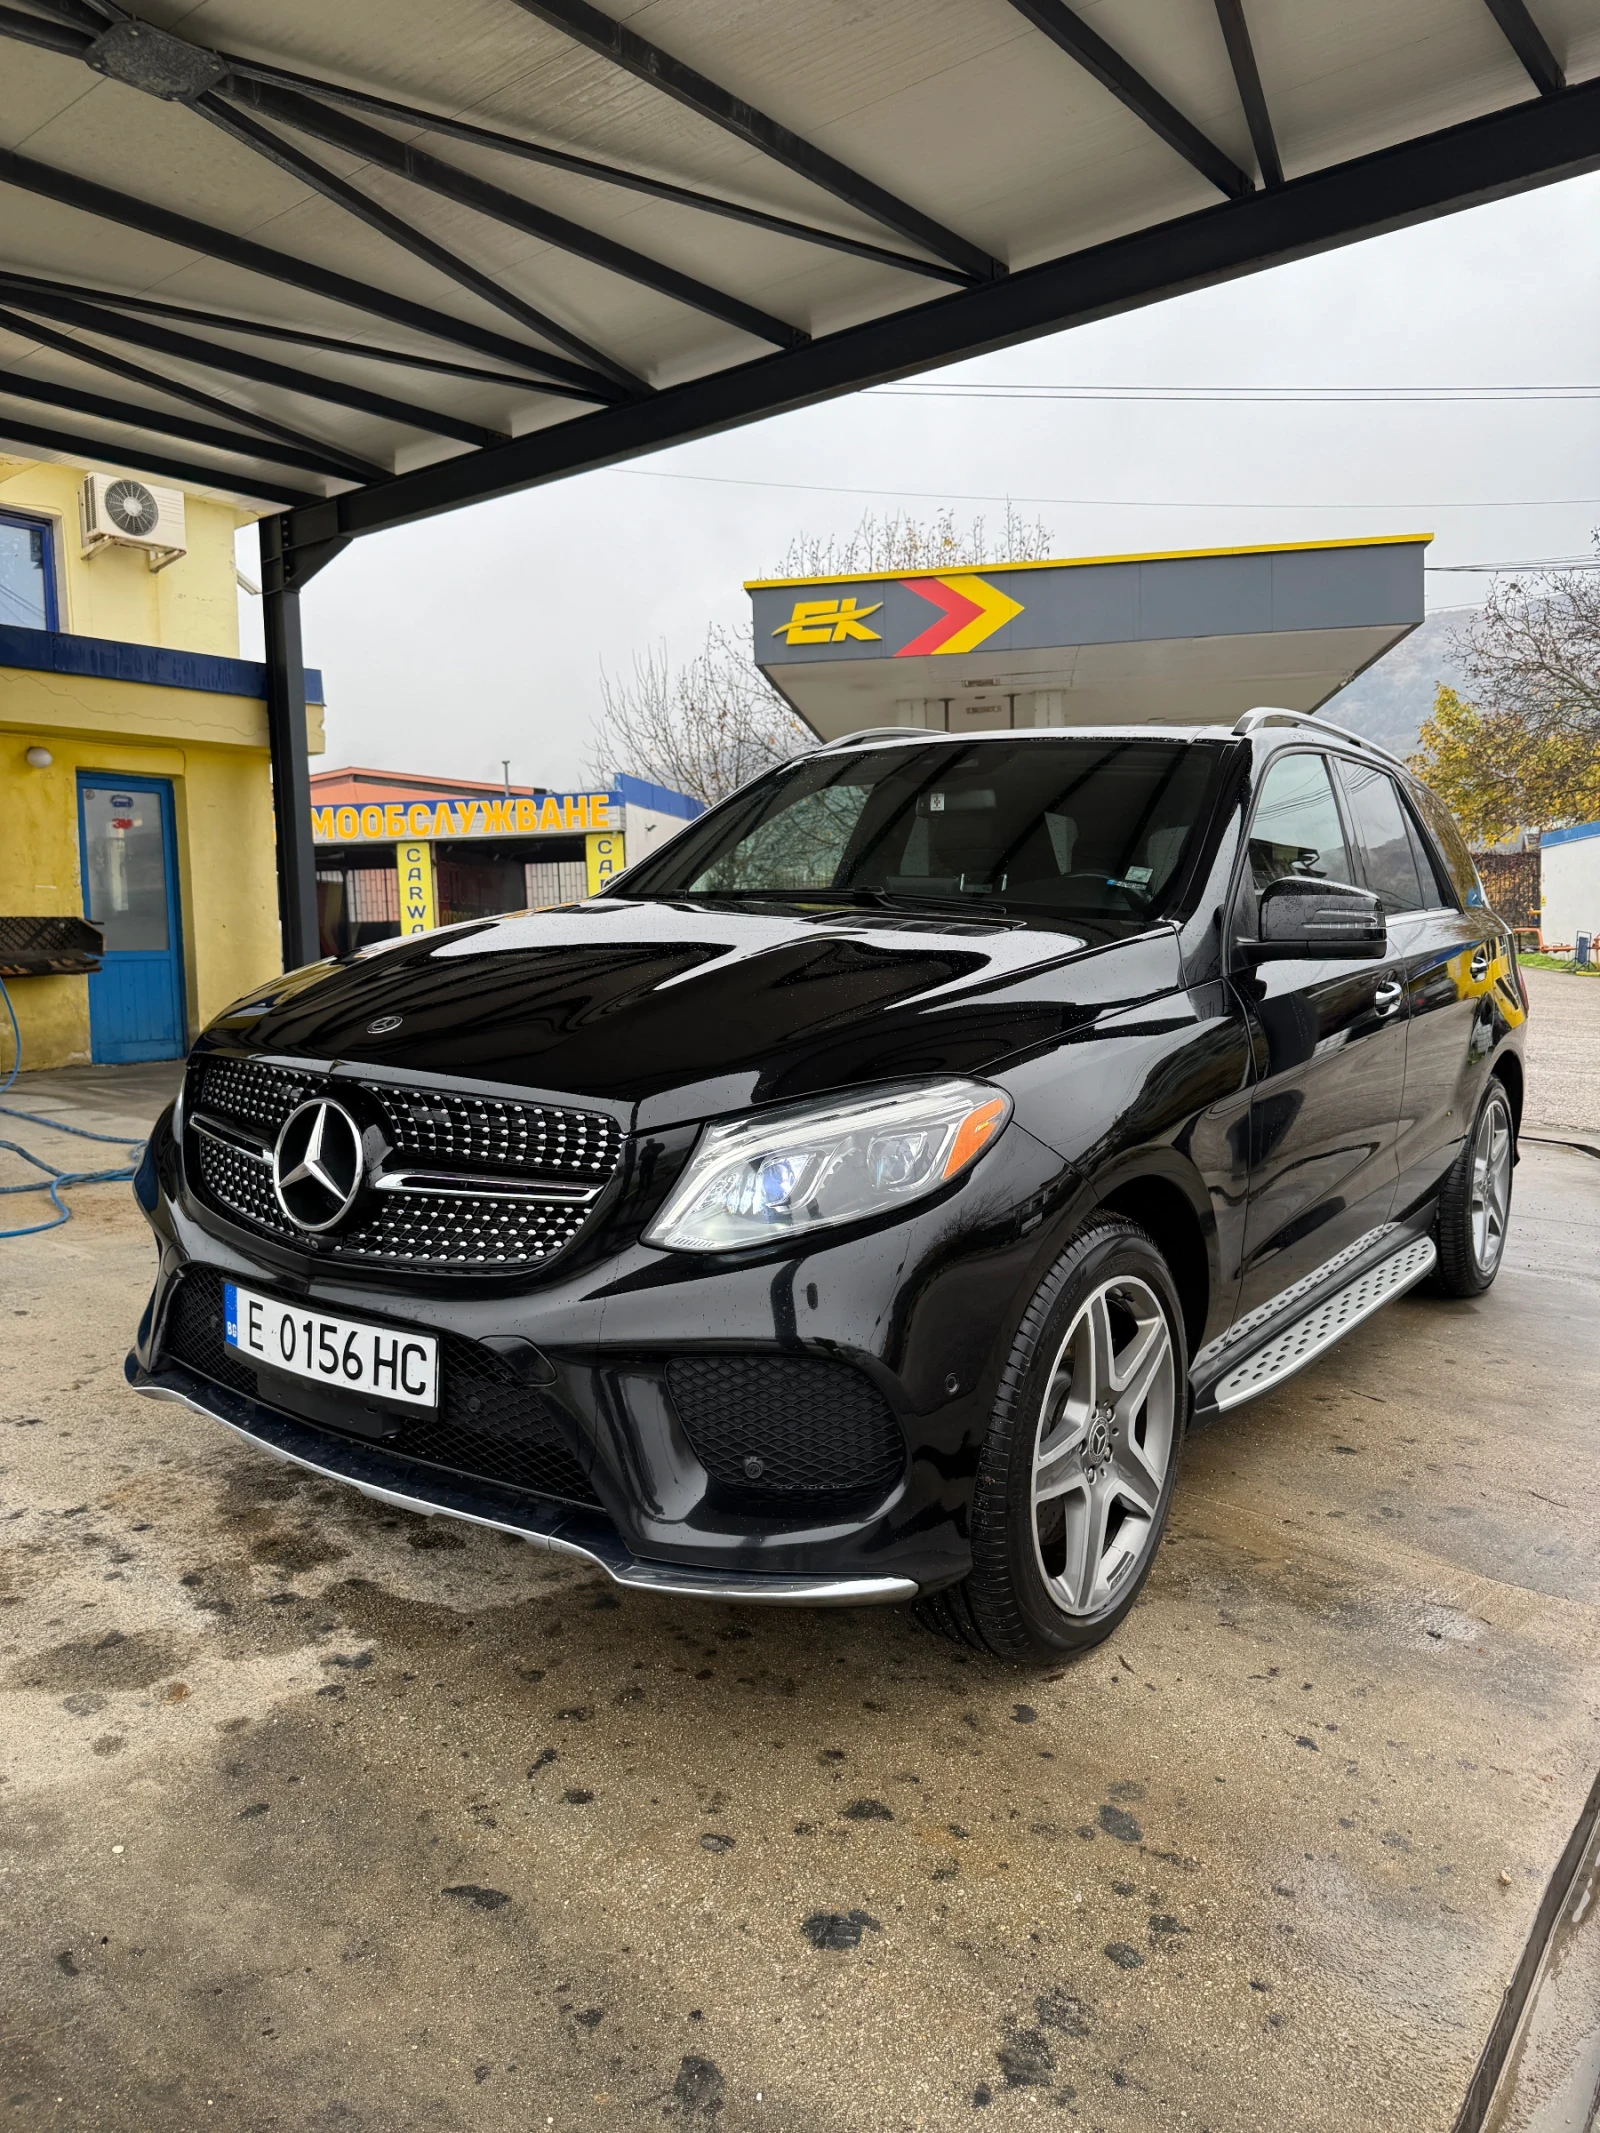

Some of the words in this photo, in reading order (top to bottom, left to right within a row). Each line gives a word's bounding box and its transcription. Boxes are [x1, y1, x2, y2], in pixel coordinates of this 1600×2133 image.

[227, 1321, 238, 1337] BG
[249, 1299, 264, 1351] E
[280, 1313, 363, 1381] 0156
